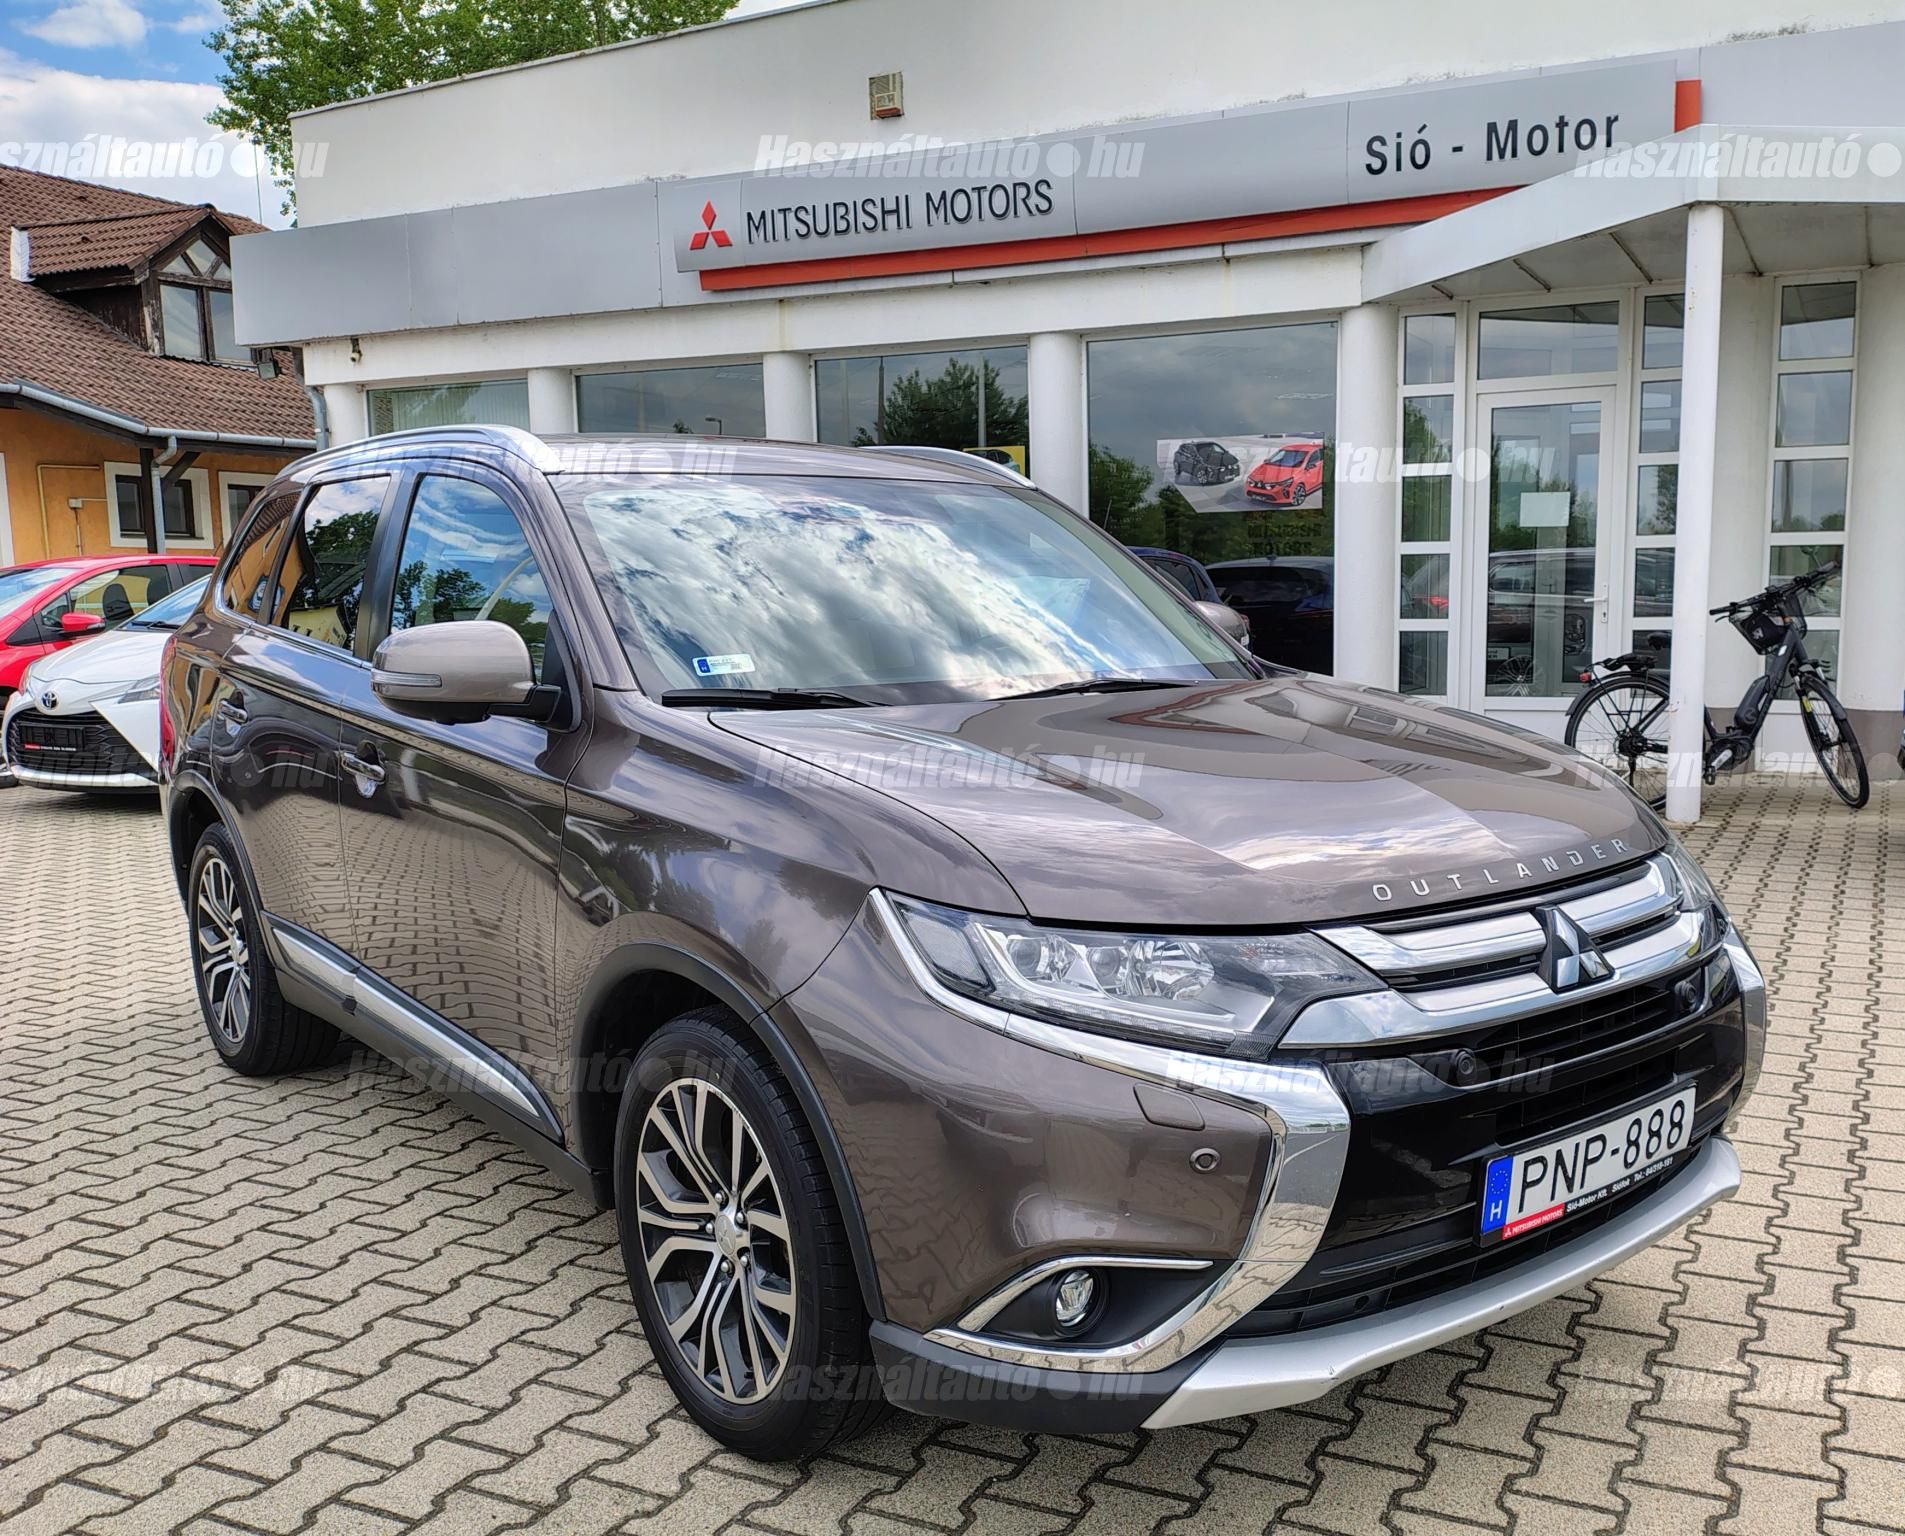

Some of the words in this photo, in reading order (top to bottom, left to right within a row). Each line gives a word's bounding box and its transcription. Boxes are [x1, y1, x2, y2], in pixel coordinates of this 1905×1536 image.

[1365, 123, 1431, 175] Sió
[1486, 114, 1619, 161] Motor
[746, 194, 912, 244] MITSUBISHI
[926, 178, 1055, 226] MOTORS
[1371, 838, 1629, 901] OUTLANDER
[1489, 1201, 1503, 1222] H
[1517, 1099, 1685, 1214] PNP-888
[1512, 1217, 1541, 1233] MITSUBISHI
[1542, 1209, 1563, 1224] MOTORS
